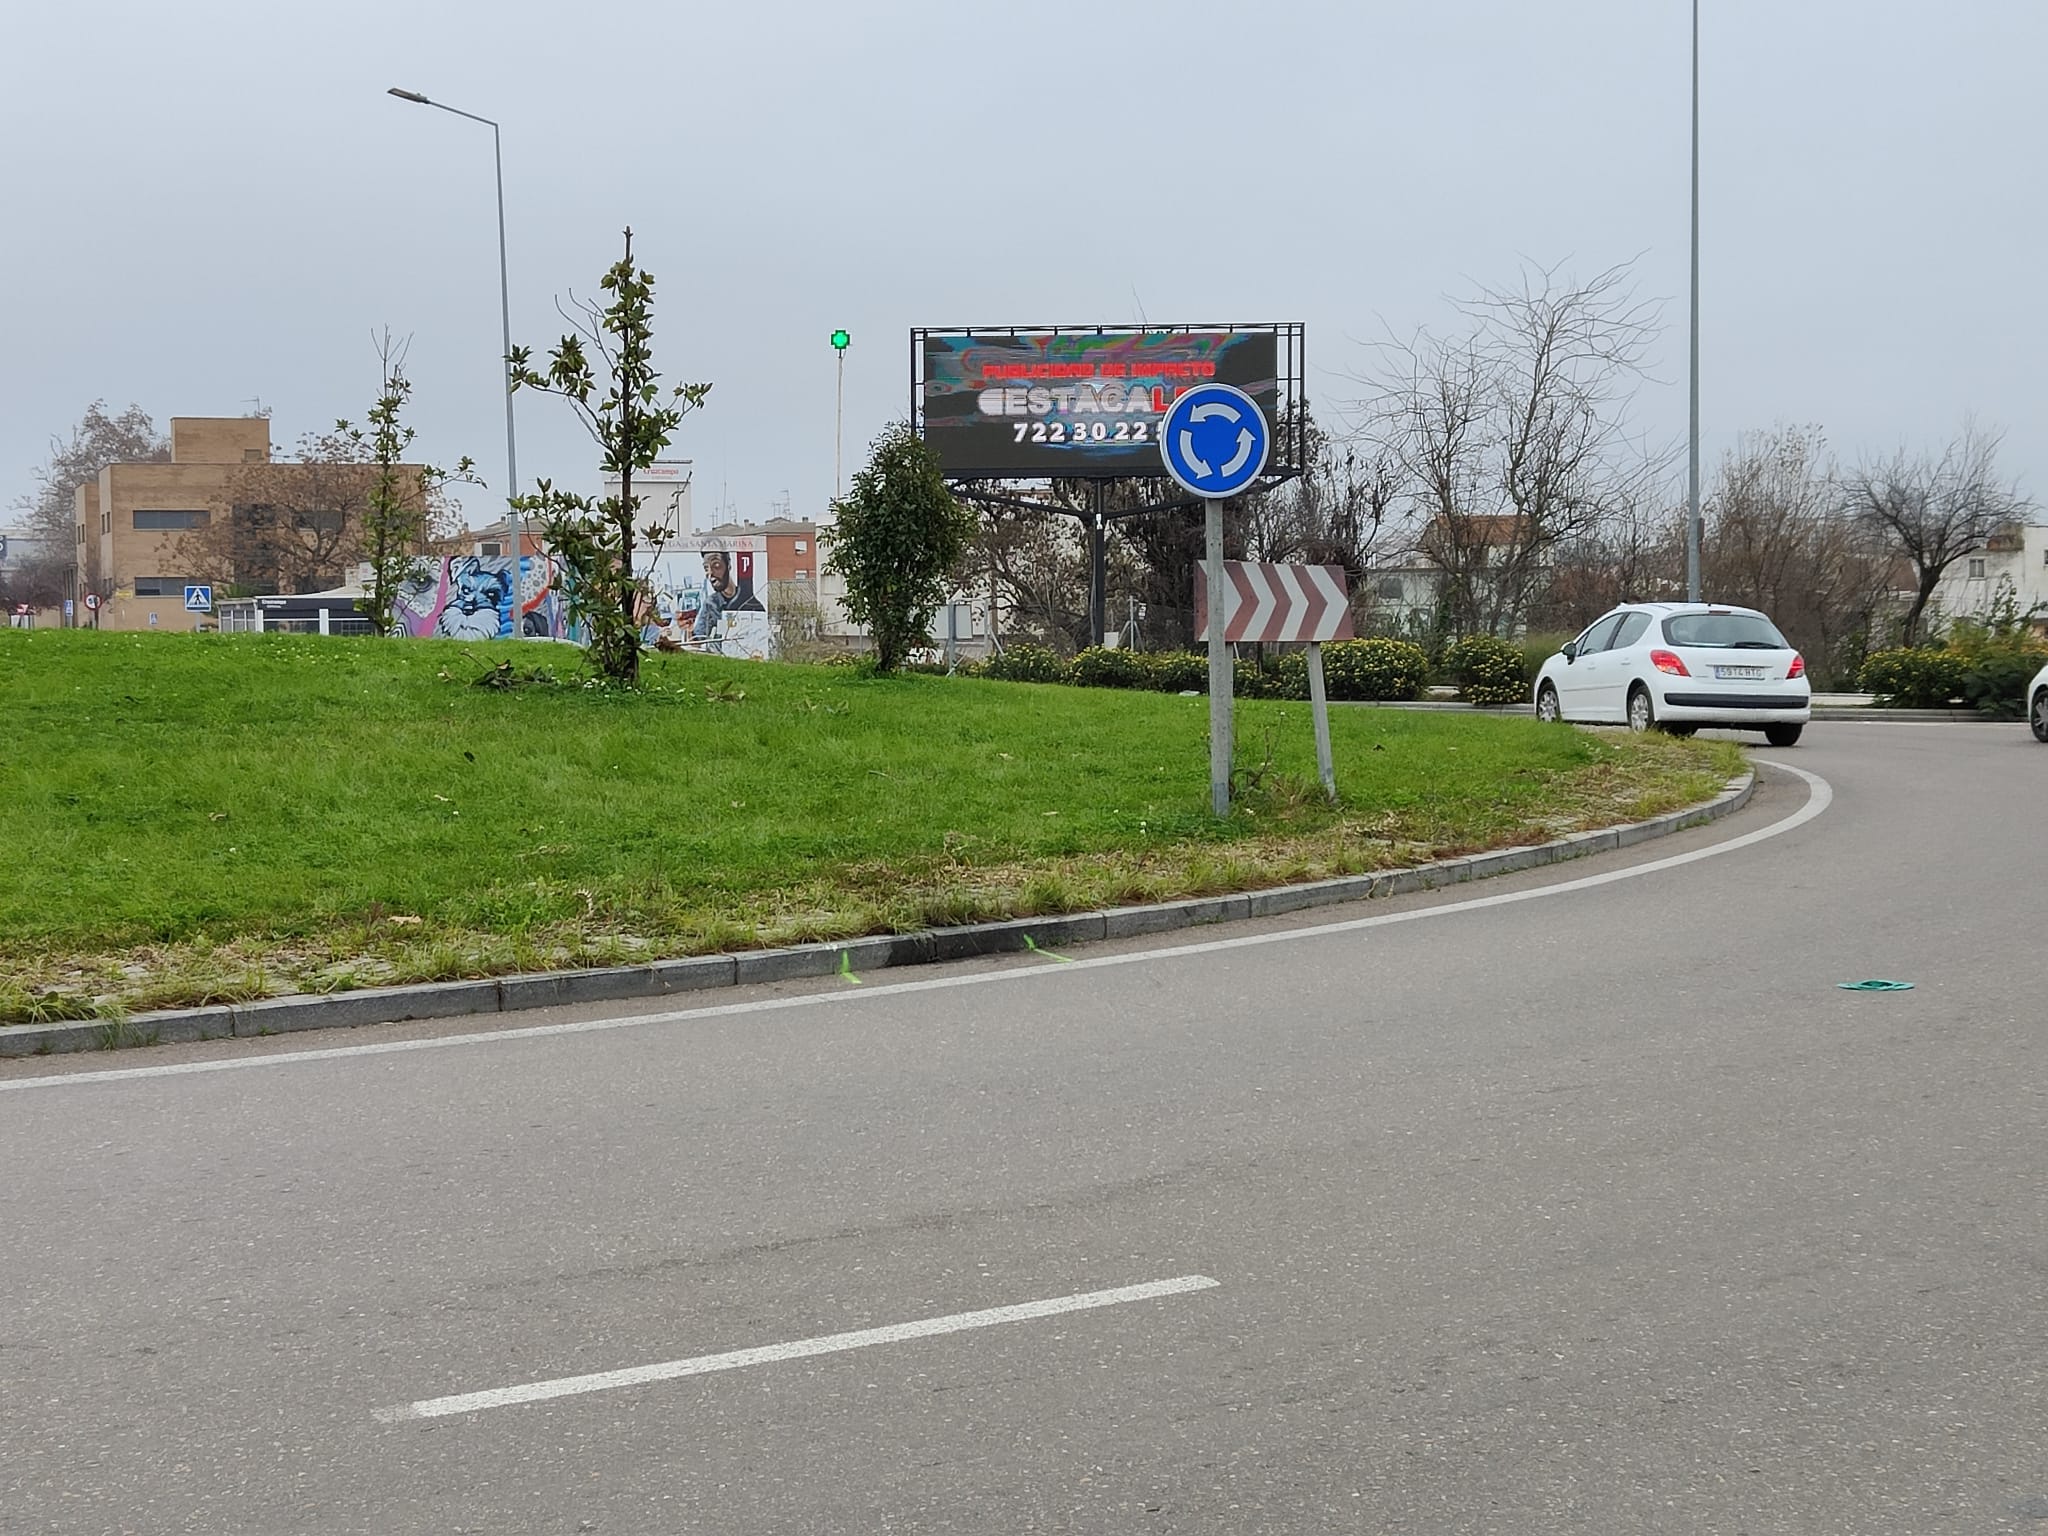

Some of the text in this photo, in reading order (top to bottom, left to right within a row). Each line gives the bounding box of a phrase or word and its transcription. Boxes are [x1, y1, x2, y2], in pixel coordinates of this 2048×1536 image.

[982, 361, 1216, 379] PUBLICIDAD DE IMPACTO
[1013, 421, 1066, 443] 722
[1072, 421, 1107, 442] 30
[1115, 421, 1148, 441] 22
